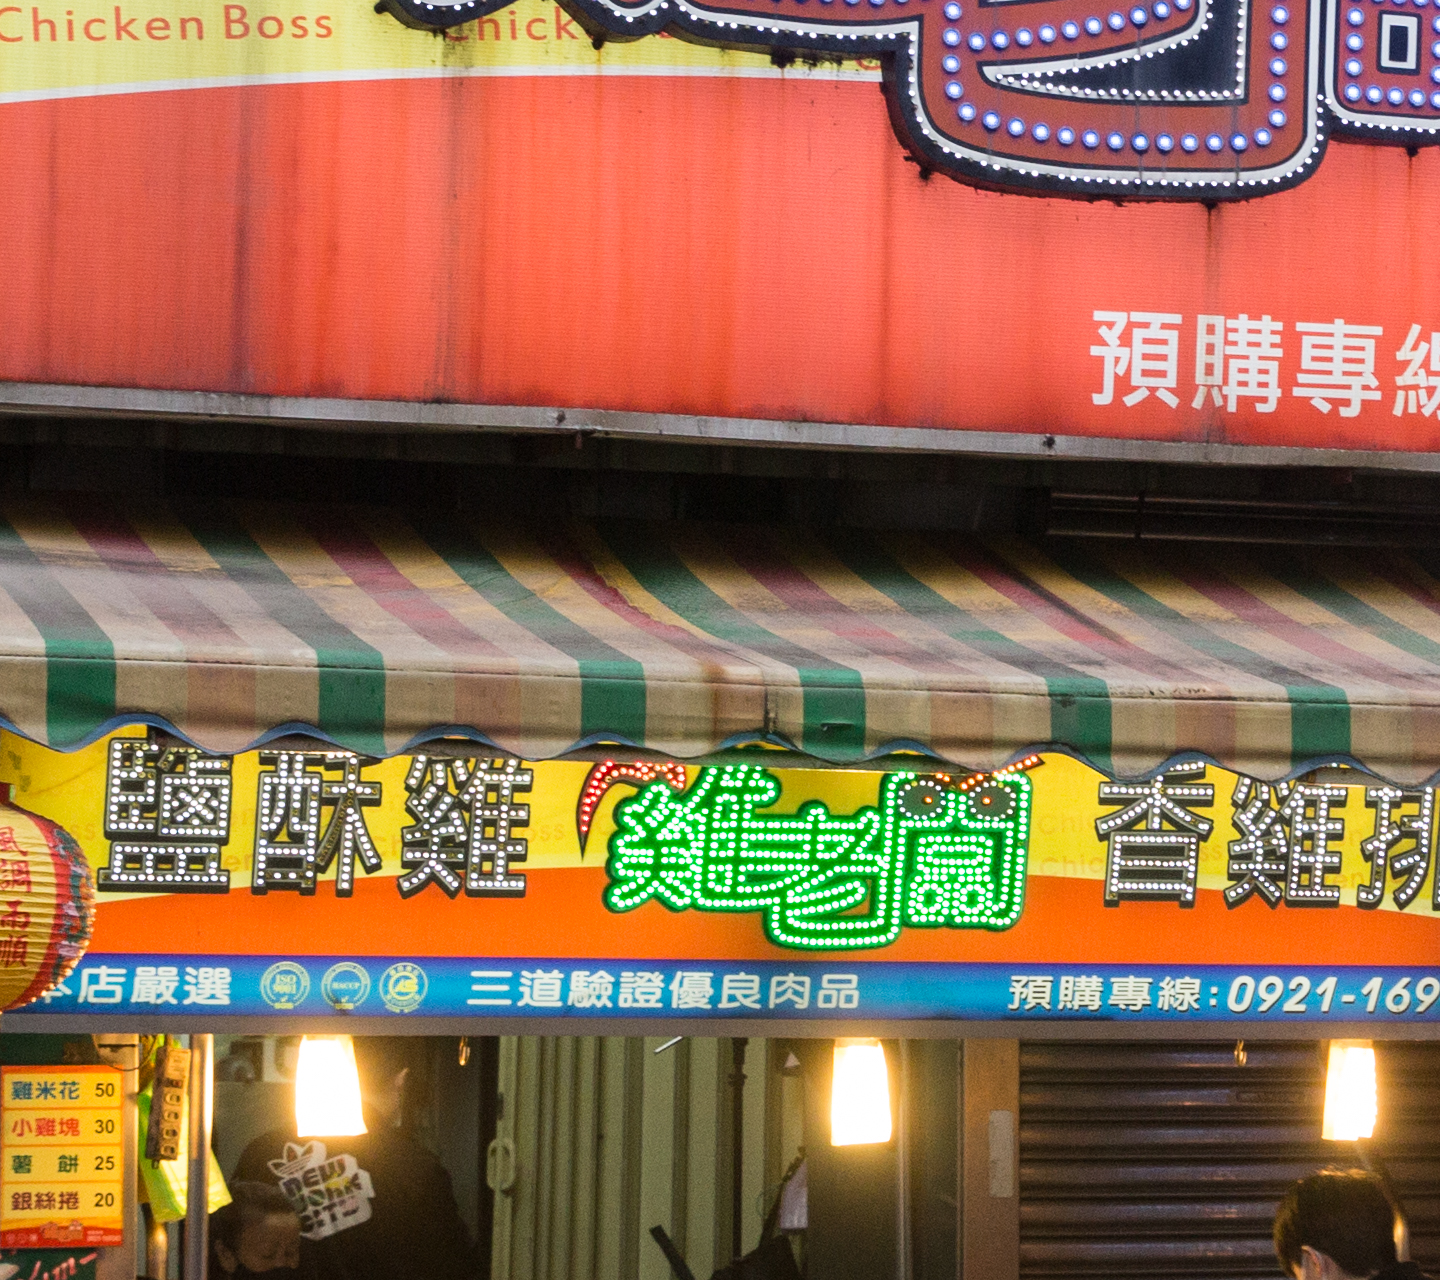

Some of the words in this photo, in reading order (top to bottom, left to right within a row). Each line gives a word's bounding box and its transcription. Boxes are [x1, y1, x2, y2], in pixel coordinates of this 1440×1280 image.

[224, 5, 332, 39] Boss
[97, 733, 533, 898] 鹽酥雞
[466, 968, 861, 1011] 三道驗證優良肉品
[11, 1081, 80, 1101] 雞米花
[95, 1083, 114, 1097] 50
[12, 1118, 80, 1137] 小雞塊
[95, 1120, 114, 1134] 30
[95, 1156, 115, 1170] 25
[95, 1193, 114, 1207] 20
